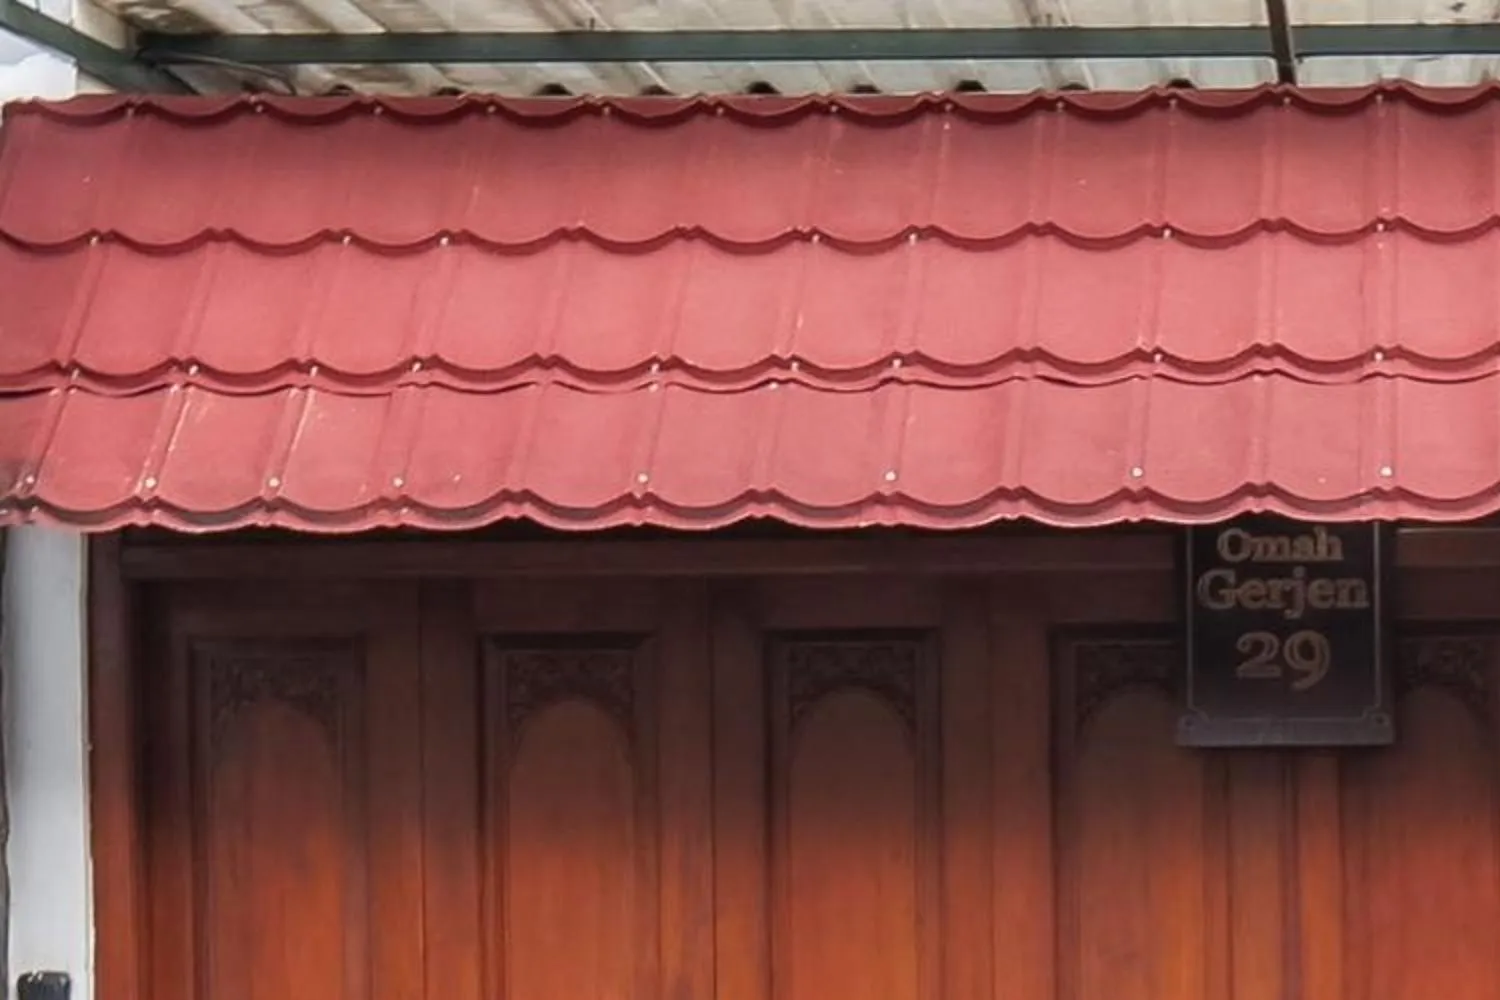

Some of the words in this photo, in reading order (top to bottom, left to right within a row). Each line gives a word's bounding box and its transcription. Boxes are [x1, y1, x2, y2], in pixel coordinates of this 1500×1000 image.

[1216, 526, 1344, 562] Omah
[1198, 566, 1370, 619] Gerjen
[1236, 629, 1331, 690] 29
